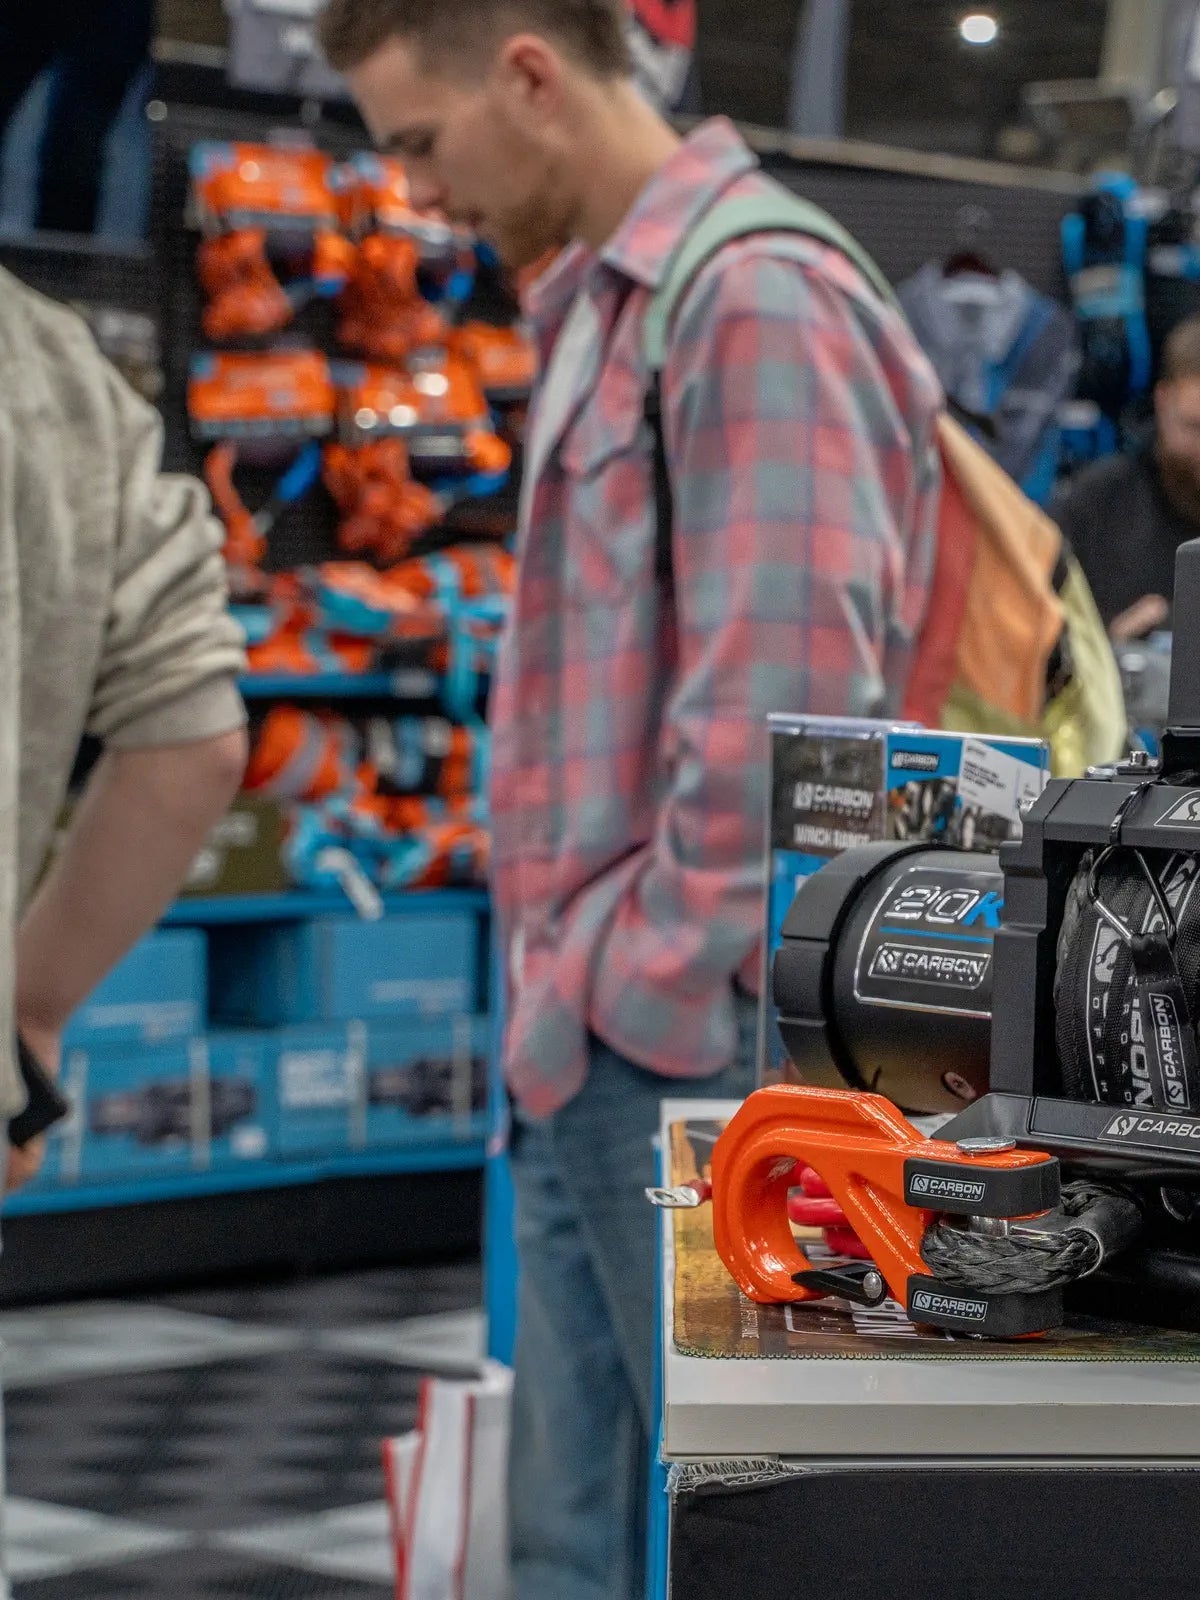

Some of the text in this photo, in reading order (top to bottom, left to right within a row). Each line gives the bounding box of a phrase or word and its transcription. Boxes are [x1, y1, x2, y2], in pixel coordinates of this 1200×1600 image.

[812, 785, 874, 808] CARBON
[884, 885, 1004, 929] 20K
[903, 953, 984, 976] CARBON
[1154, 998, 1177, 1078] CARBON
[930, 1179, 983, 1195] CARBON
[931, 1296, 985, 1313] CARBON
